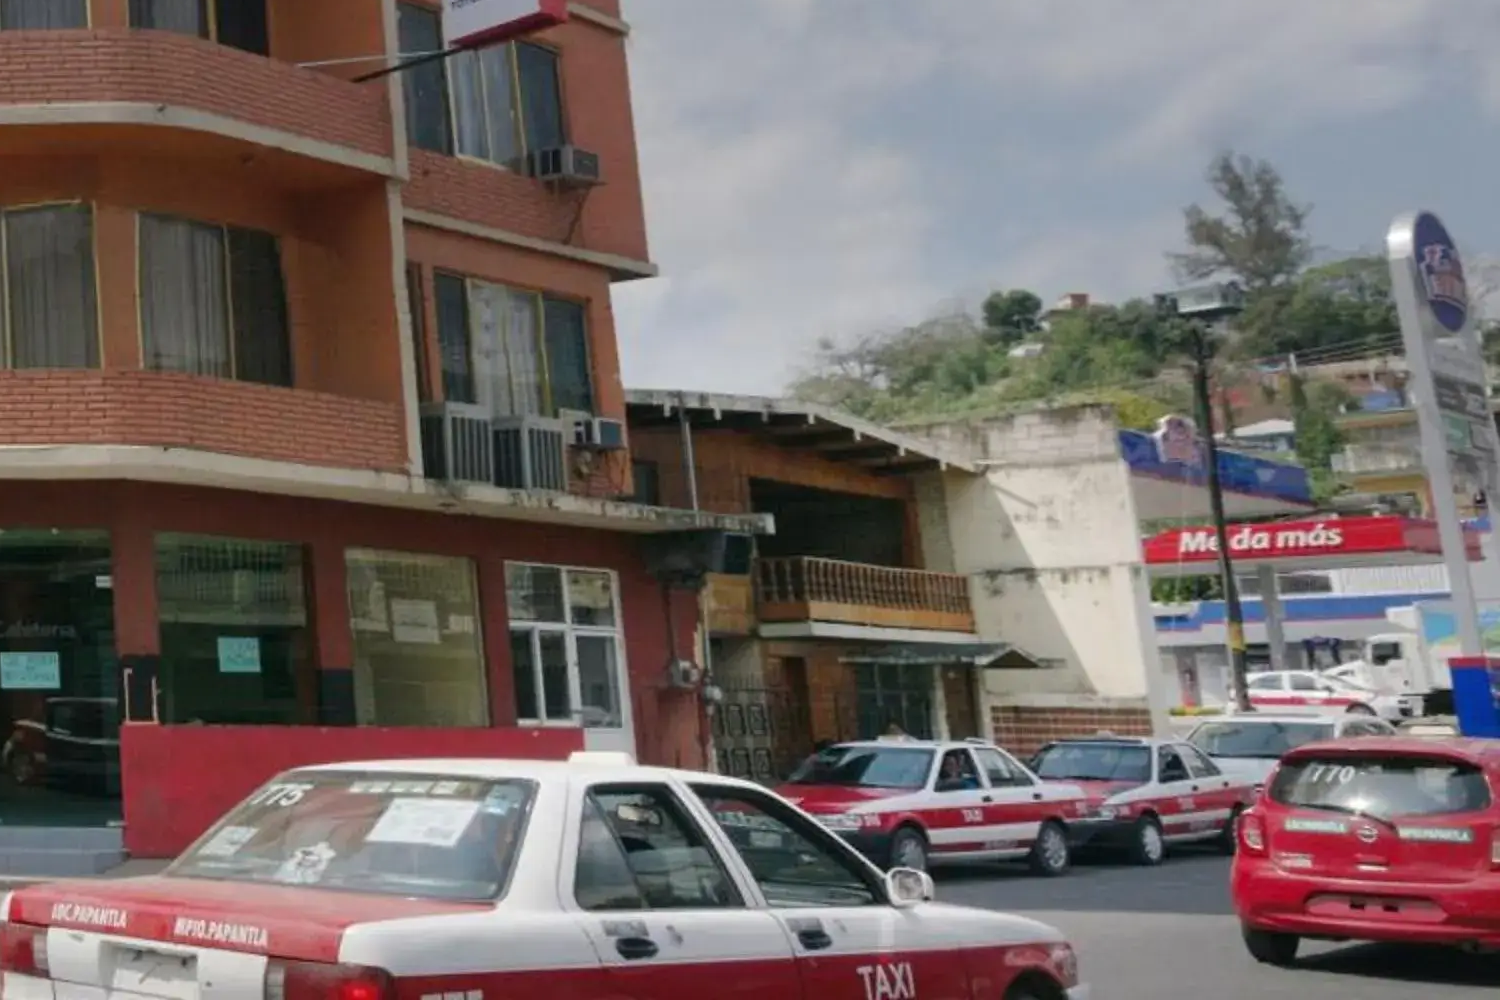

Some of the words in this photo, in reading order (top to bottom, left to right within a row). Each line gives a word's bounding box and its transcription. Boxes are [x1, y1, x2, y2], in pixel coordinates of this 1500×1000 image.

[1230, 527, 1270, 550] da
[1275, 523, 1343, 547] más
[251, 783, 315, 807] 775
[856, 963, 916, 1000] TAXI
